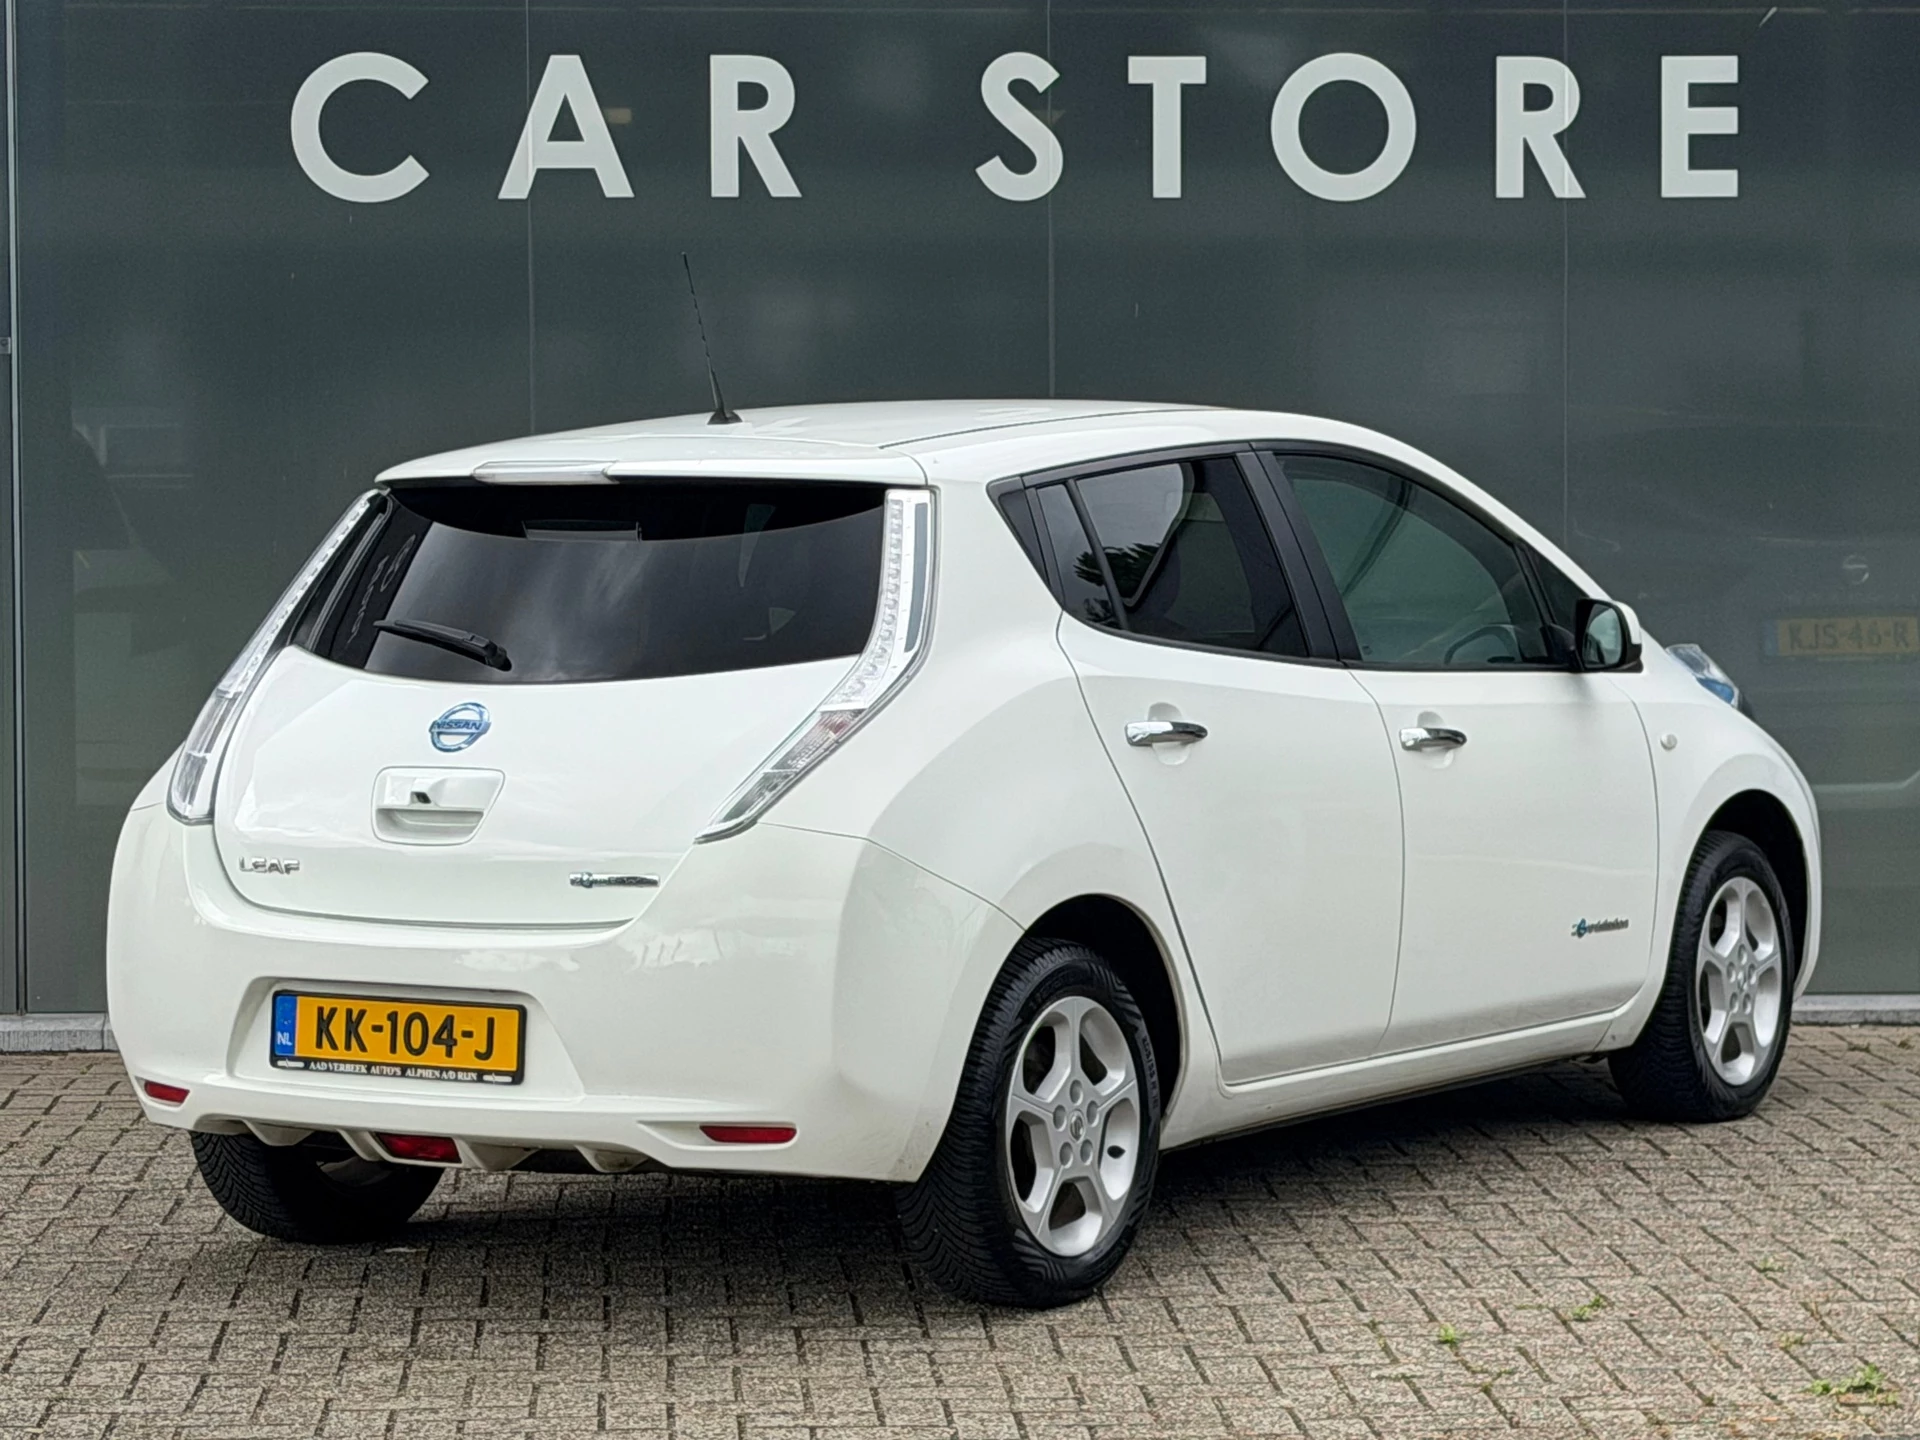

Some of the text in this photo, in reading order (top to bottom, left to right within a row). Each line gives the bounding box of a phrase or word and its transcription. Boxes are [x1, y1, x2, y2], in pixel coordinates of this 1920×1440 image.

[290, 51, 1738, 203] CAR STORE
[434, 721, 482, 730] NISSAN
[239, 856, 300, 875] LEAF
[277, 1032, 293, 1046] NL
[315, 1006, 495, 1061] KK-104-J
[309, 1061, 327, 1070] AAD
[328, 1062, 368, 1074] VERBEEK
[370, 1066, 401, 1076] AUTO'S
[405, 1068, 441, 1079] ALPHEN
[457, 1071, 478, 1081] RIJN
